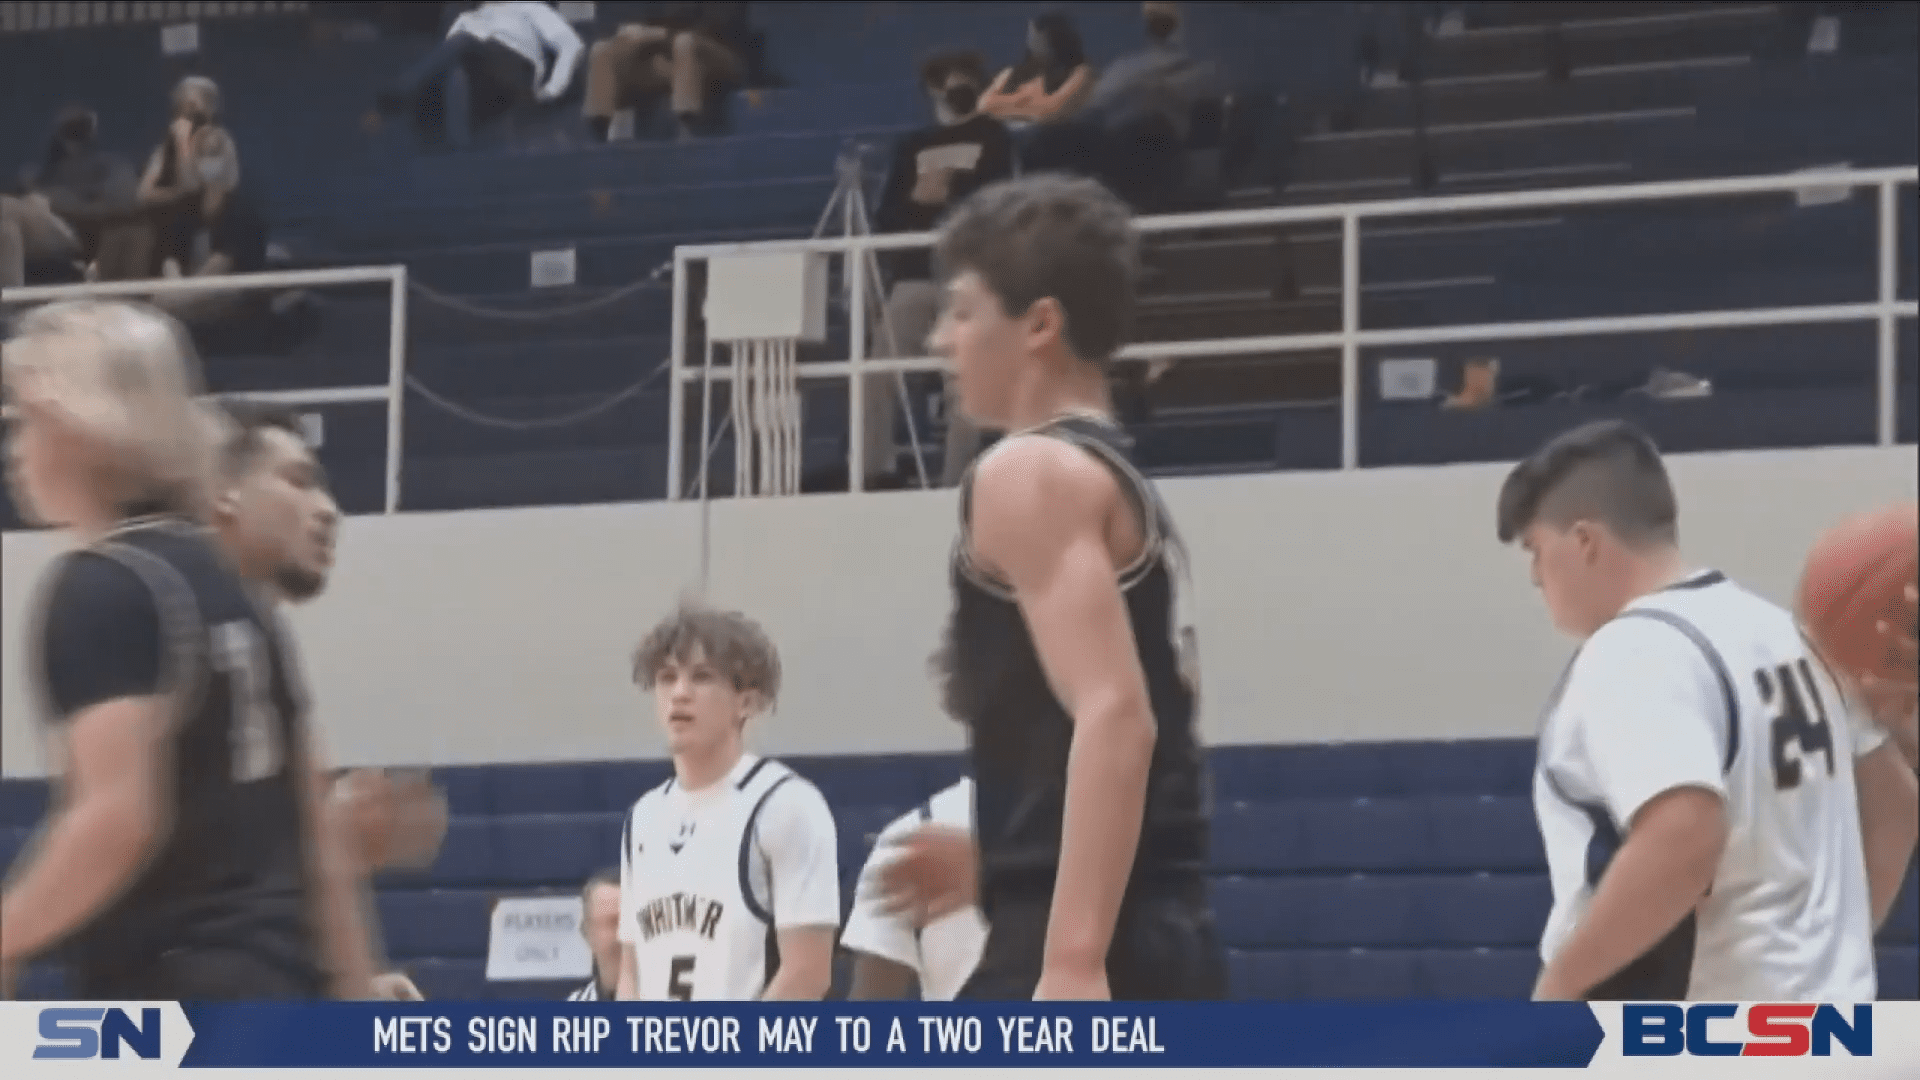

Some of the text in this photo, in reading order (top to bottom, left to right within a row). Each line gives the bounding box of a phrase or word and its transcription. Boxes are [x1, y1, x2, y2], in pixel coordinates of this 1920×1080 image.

[1753, 657, 1835, 790] 24
[635, 891, 725, 943] WHITMR
[667, 954, 697, 1000] 5
